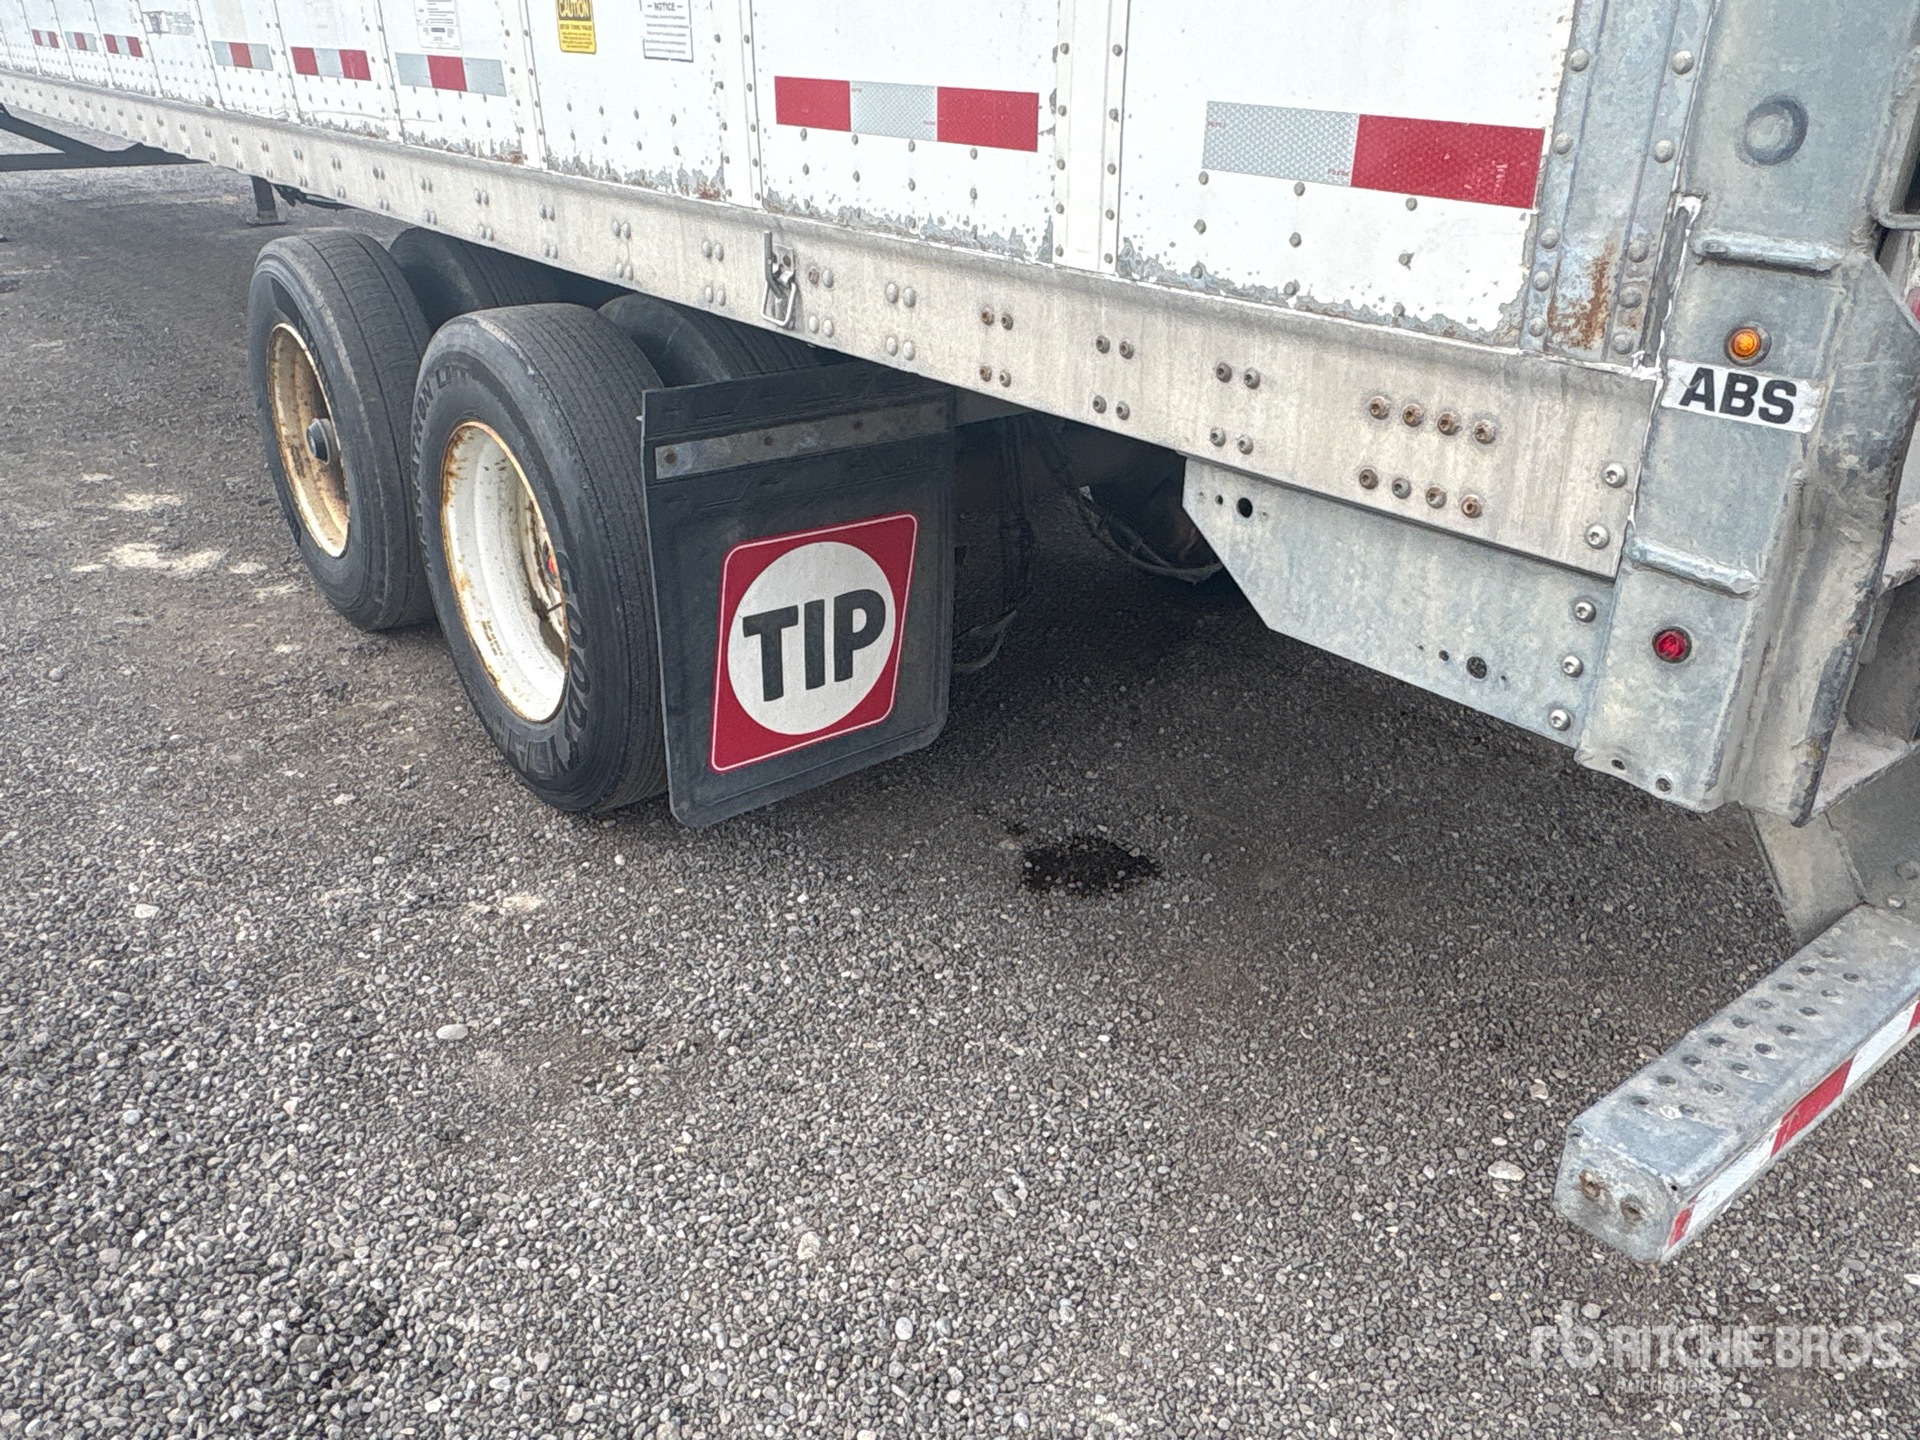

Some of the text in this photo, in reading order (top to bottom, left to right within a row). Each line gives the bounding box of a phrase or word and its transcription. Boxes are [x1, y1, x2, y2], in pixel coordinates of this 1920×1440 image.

[559, 0, 590, 18] CAUTION
[1679, 367, 1797, 424] ABS
[742, 588, 886, 702] TIP
